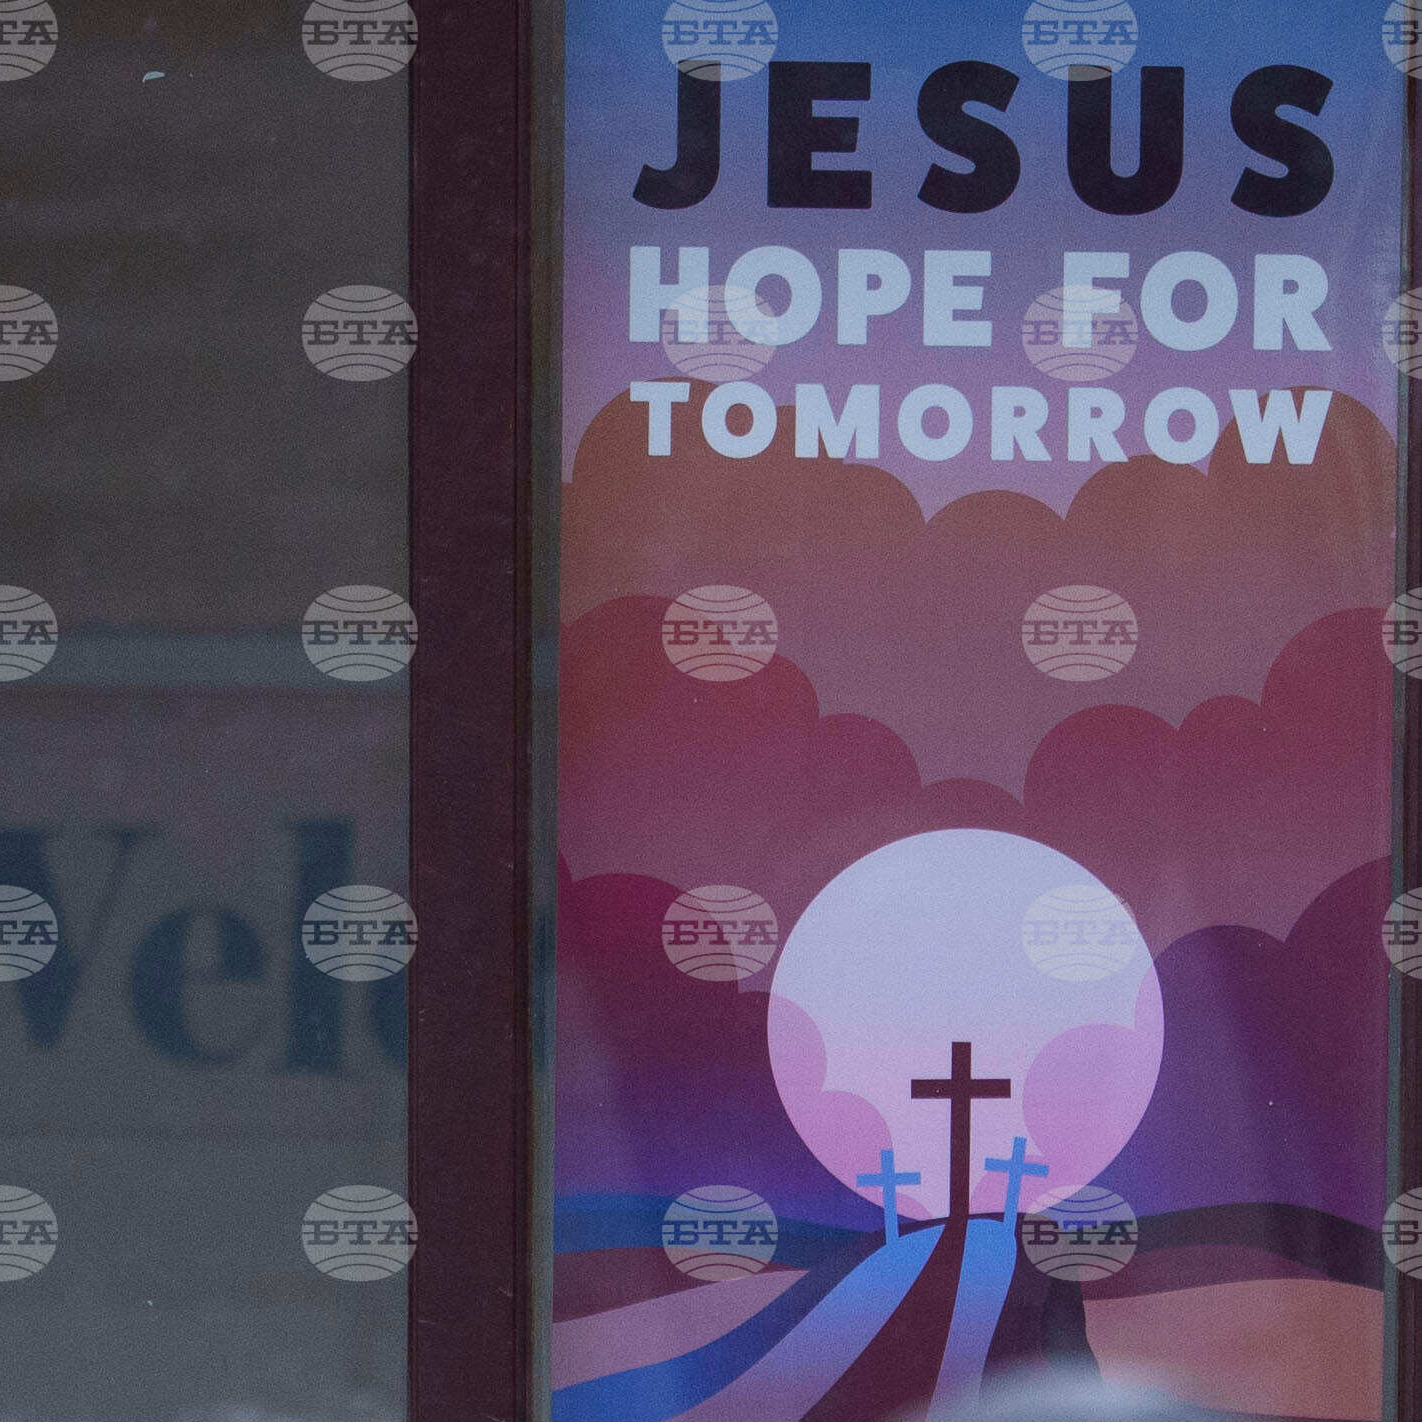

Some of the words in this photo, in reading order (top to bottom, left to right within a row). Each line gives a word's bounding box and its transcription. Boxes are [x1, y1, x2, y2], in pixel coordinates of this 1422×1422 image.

[633, 60, 1336, 217] JESUS
[629, 246, 993, 347] HOPE
[1063, 251, 1333, 352] FOR
[629, 382, 1333, 467] TOMORROW
